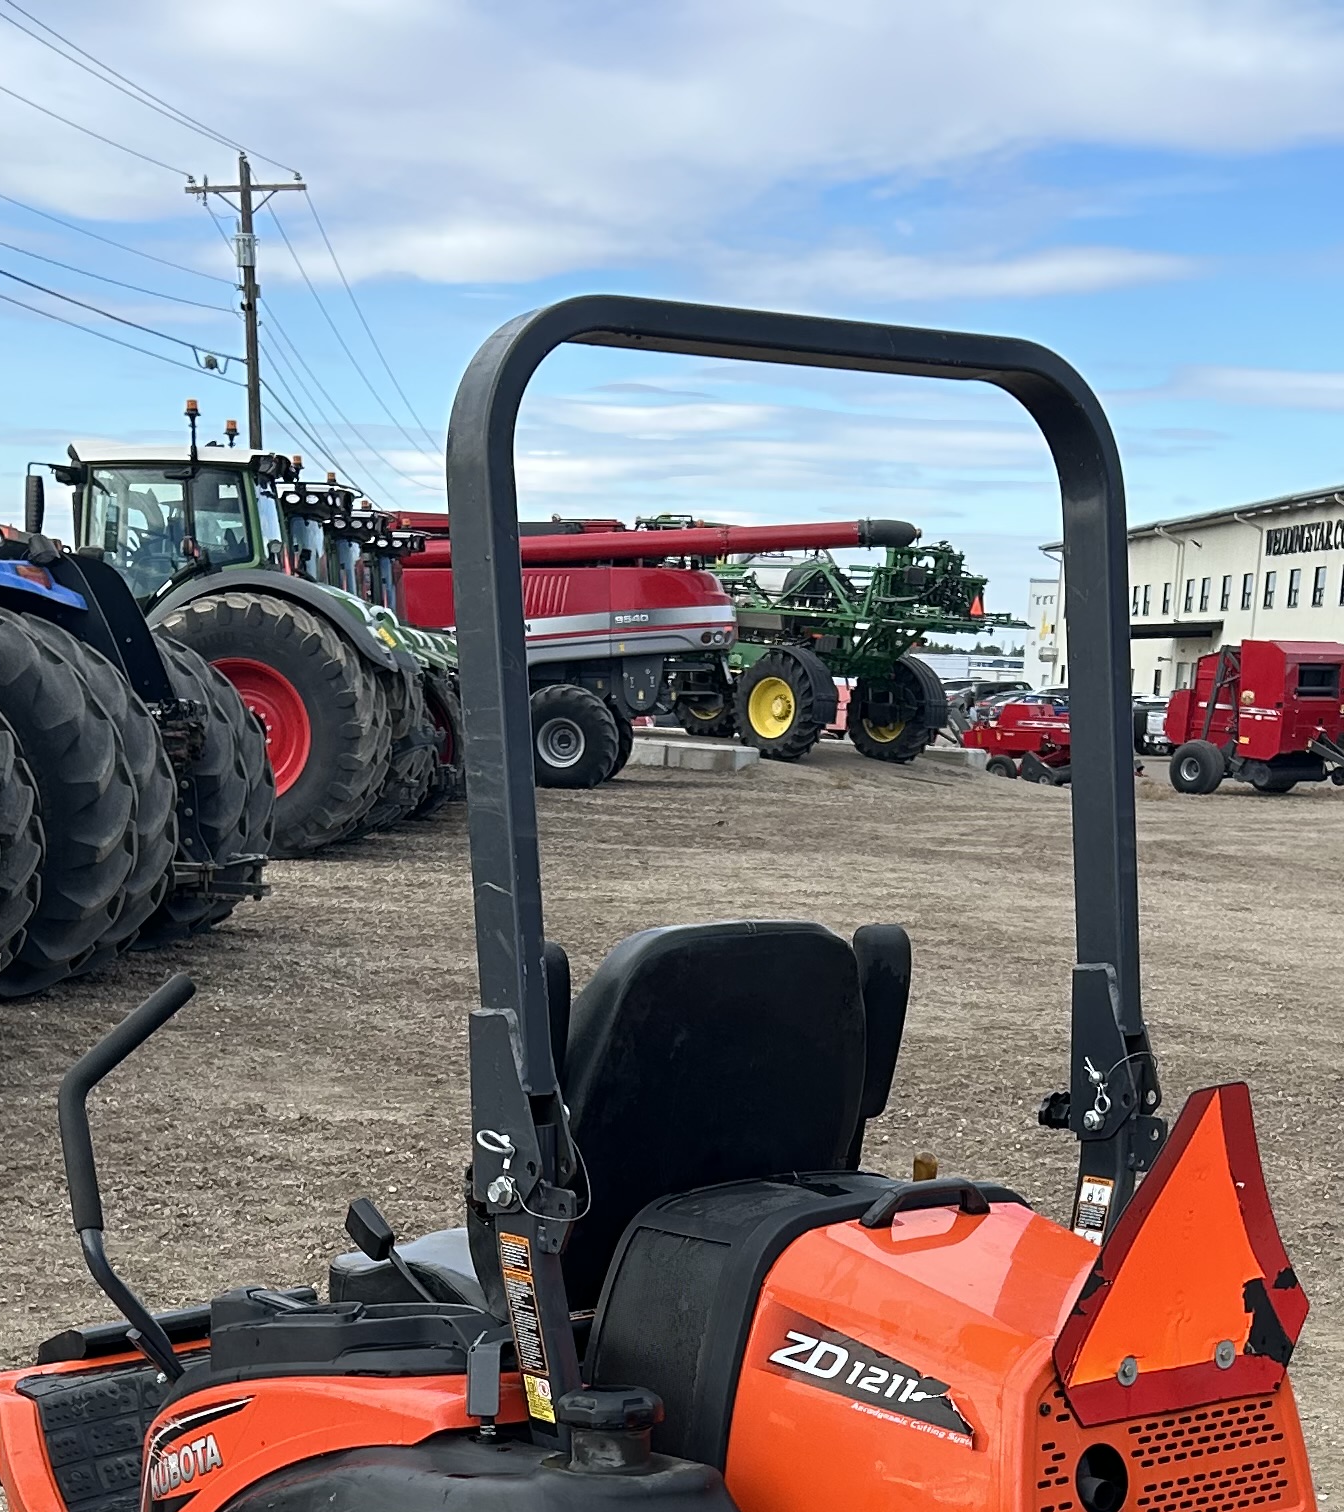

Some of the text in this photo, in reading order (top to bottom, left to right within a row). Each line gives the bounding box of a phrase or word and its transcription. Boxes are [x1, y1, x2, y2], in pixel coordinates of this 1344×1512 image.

[851, 1402, 908, 1426] Aerodynamic
[910, 1420, 946, 1438] Cutting
[151, 1434, 224, 1499] KUBOTA
